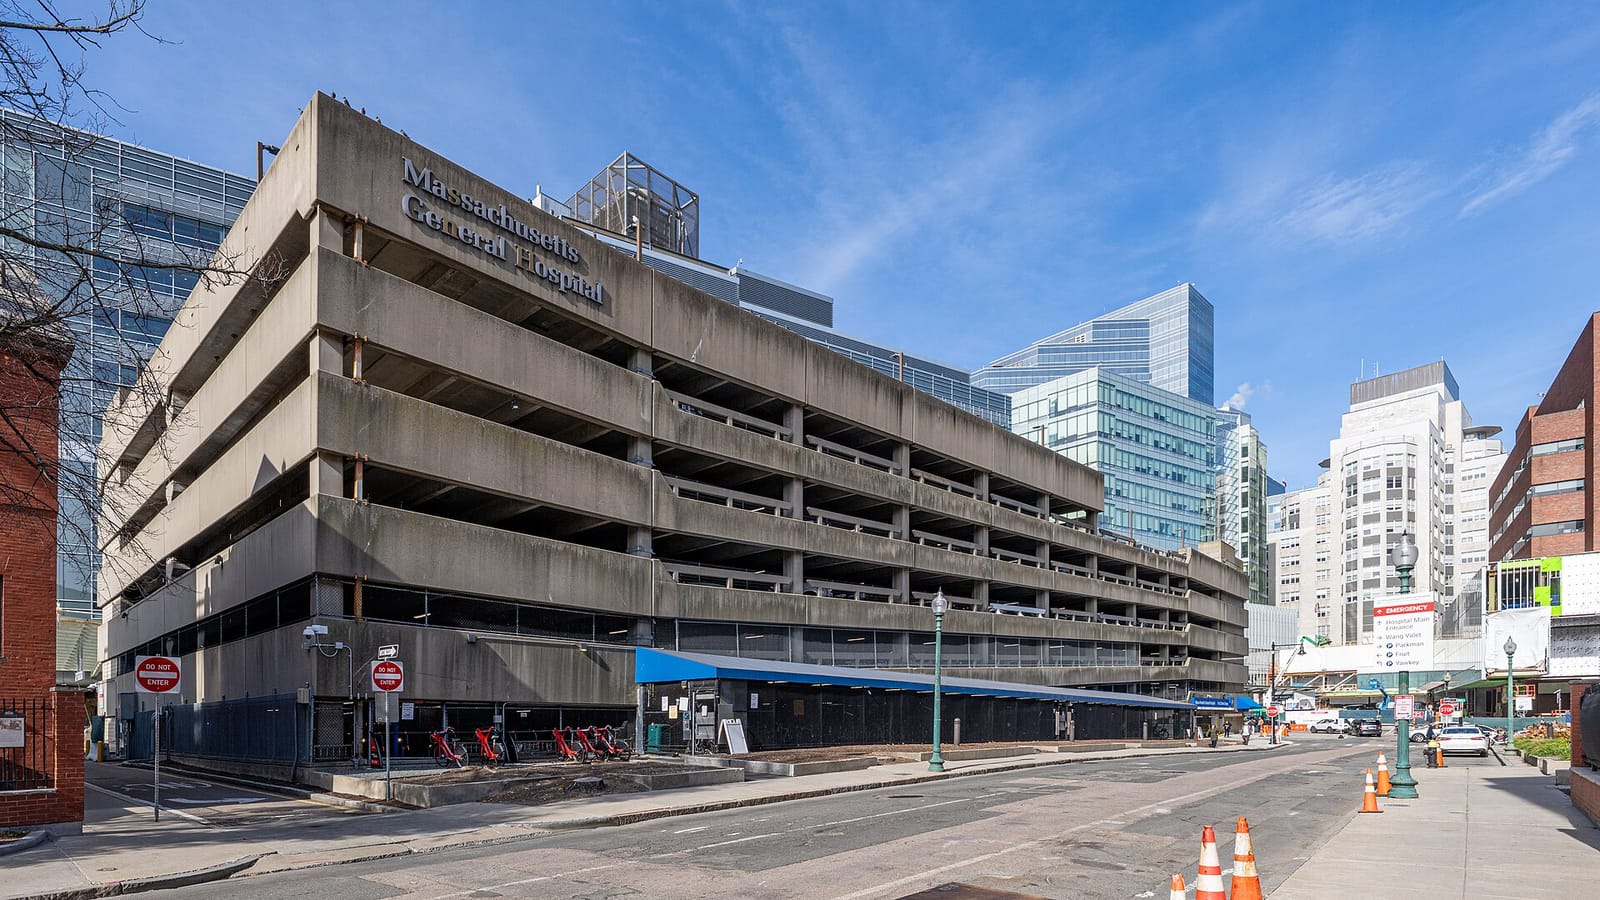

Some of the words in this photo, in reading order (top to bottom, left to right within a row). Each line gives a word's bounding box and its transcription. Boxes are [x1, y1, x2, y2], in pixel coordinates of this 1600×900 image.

[401, 156, 579, 263] Massachusetts
[402, 194, 506, 261] General
[514, 244, 604, 305] Hospital
[1386, 605, 1428, 614] EMERGENCY
